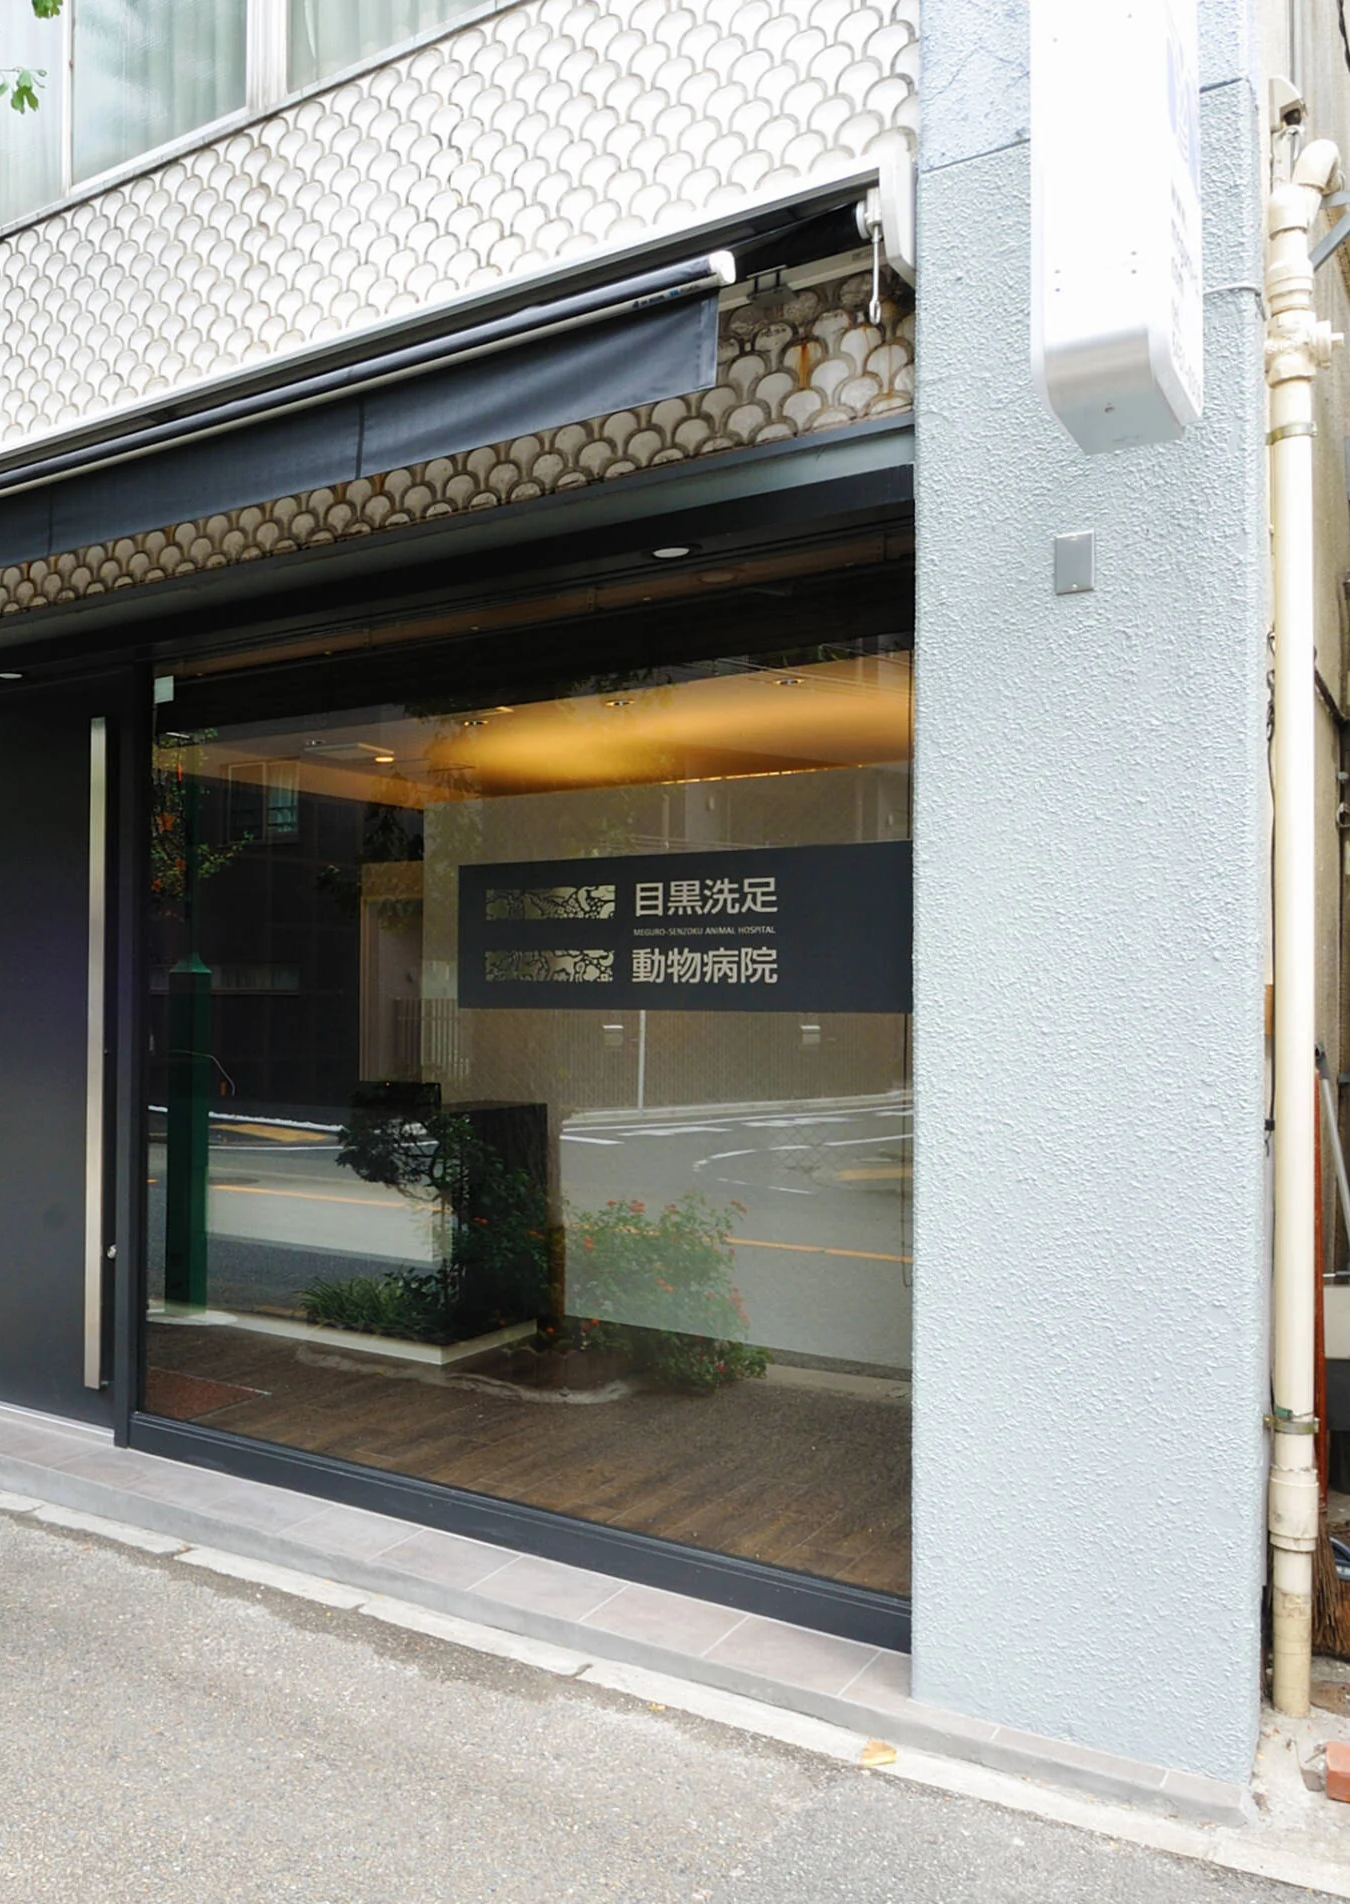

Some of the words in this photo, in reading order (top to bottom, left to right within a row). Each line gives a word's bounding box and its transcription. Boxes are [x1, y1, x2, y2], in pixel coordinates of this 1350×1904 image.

[634, 877, 779, 917] 目黒洗足
[633, 928, 703, 937] MEGURO-SENZOKU
[705, 926, 736, 935] ANIMAL
[738, 925, 776, 934] HOSPITAL
[631, 946, 779, 984] 動物病院
